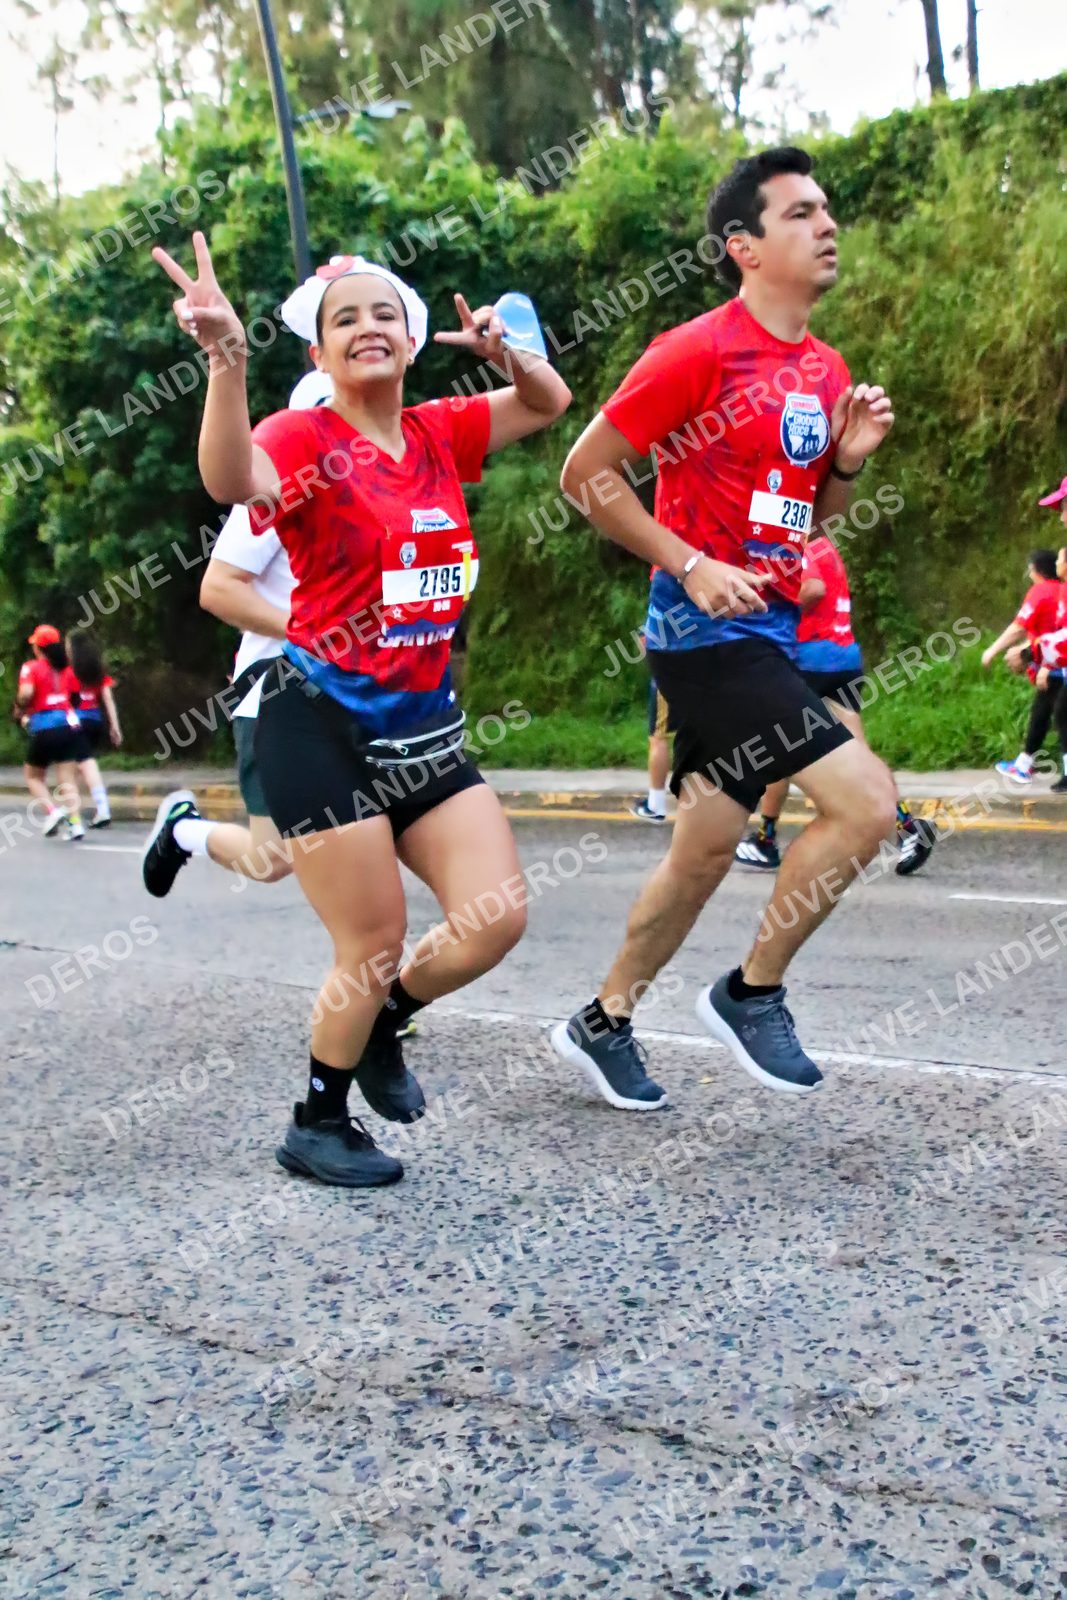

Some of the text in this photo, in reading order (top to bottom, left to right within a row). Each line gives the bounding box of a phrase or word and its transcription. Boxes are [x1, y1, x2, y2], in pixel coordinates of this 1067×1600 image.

[794, 411, 818, 427] Global
[788, 424, 810, 437] Race
[419, 566, 461, 597] 2795
